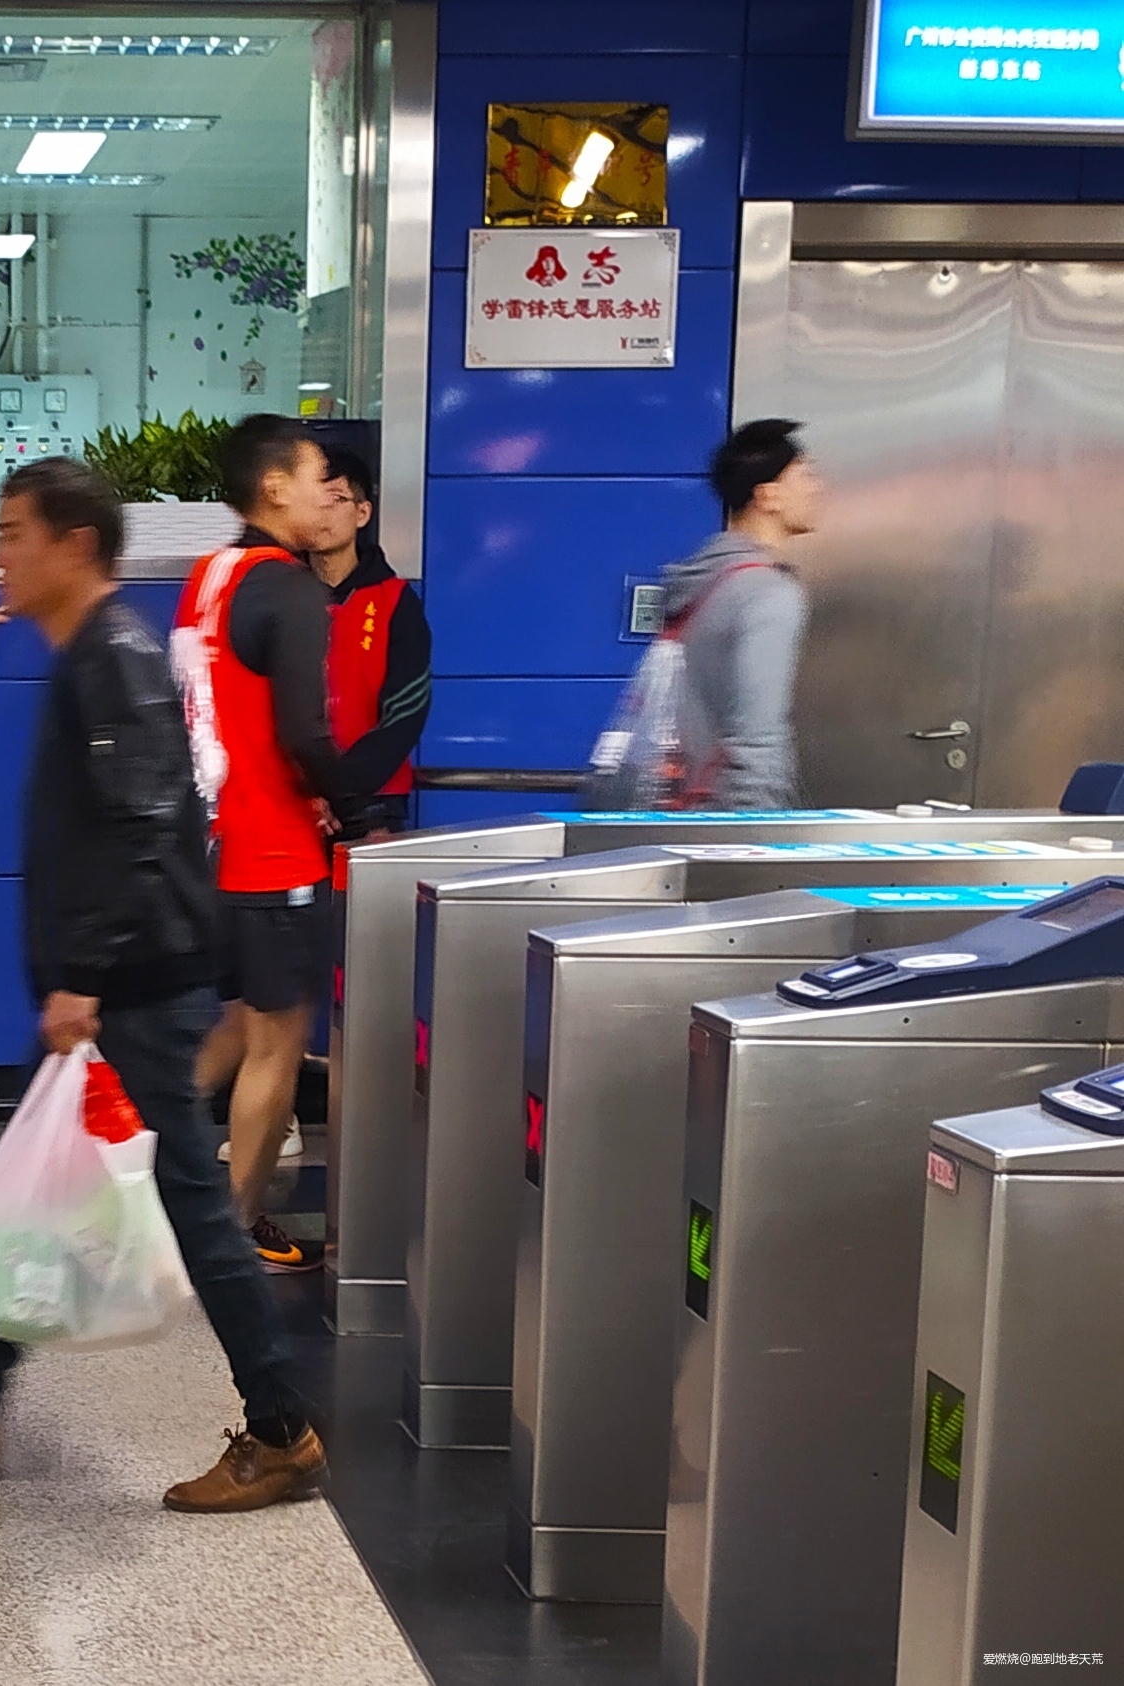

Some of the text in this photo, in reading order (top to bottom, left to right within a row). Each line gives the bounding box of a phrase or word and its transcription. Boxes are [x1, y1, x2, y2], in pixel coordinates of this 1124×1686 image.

[481, 298, 662, 320] 学雷锋志愿服务站
